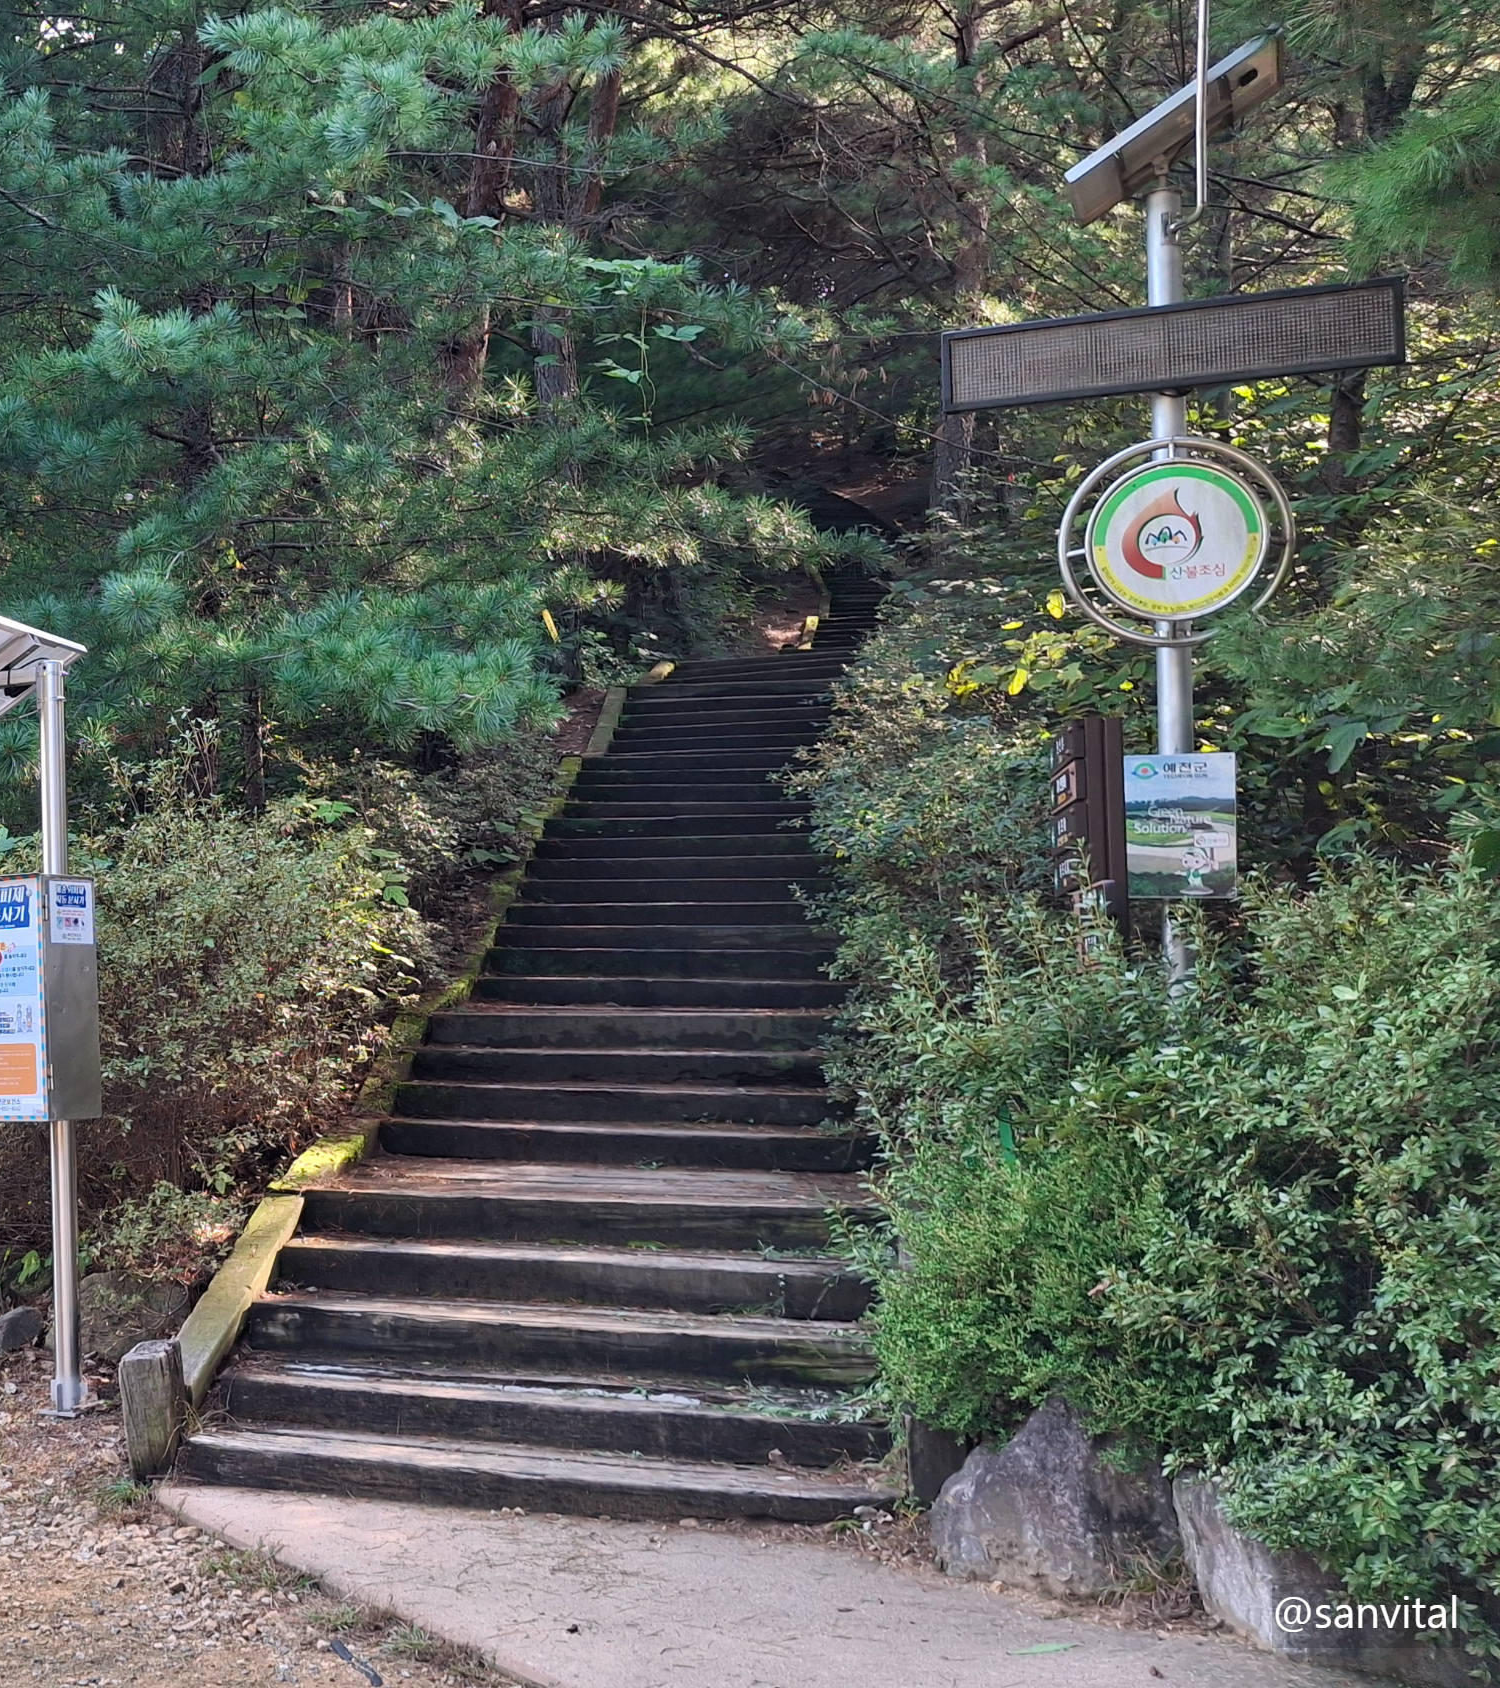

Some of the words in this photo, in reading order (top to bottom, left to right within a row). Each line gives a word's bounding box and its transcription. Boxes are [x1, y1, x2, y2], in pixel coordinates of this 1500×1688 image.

[1169, 562, 1226, 580] 산불조심
[1162, 761, 1208, 773] 예천군
[1147, 805, 1184, 818] Green
[1169, 814, 1212, 826] Nature
[1133, 821, 1186, 834] Solution
